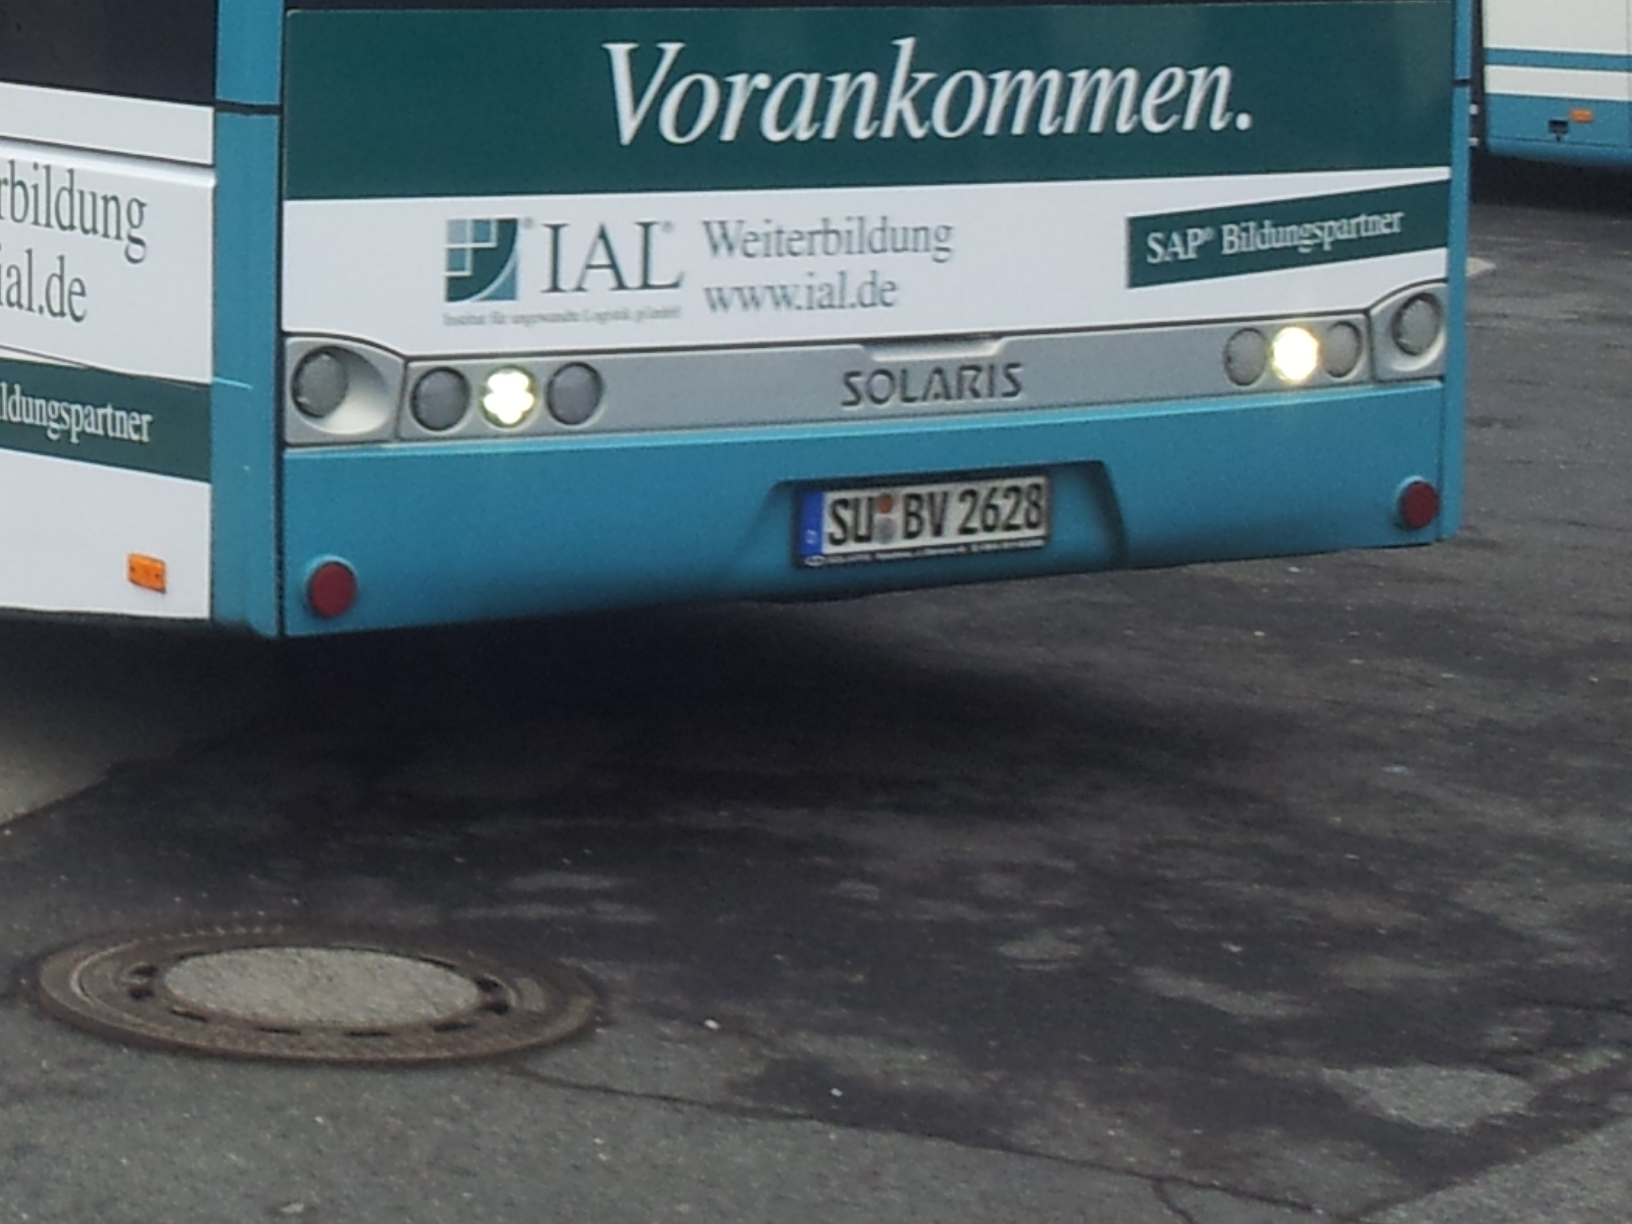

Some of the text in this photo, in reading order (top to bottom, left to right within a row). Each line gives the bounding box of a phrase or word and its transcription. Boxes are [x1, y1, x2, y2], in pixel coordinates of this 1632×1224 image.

[601, 36, 1254, 147] Vorankommen.
[700, 215, 955, 264] Weiterbildung
[1220, 211, 1405, 254] Bildungspartner
[702, 269, 899, 314] www.ial.de
[840, 361, 1024, 408] SOLARIS
[827, 481, 1044, 547] SU BV 2628
